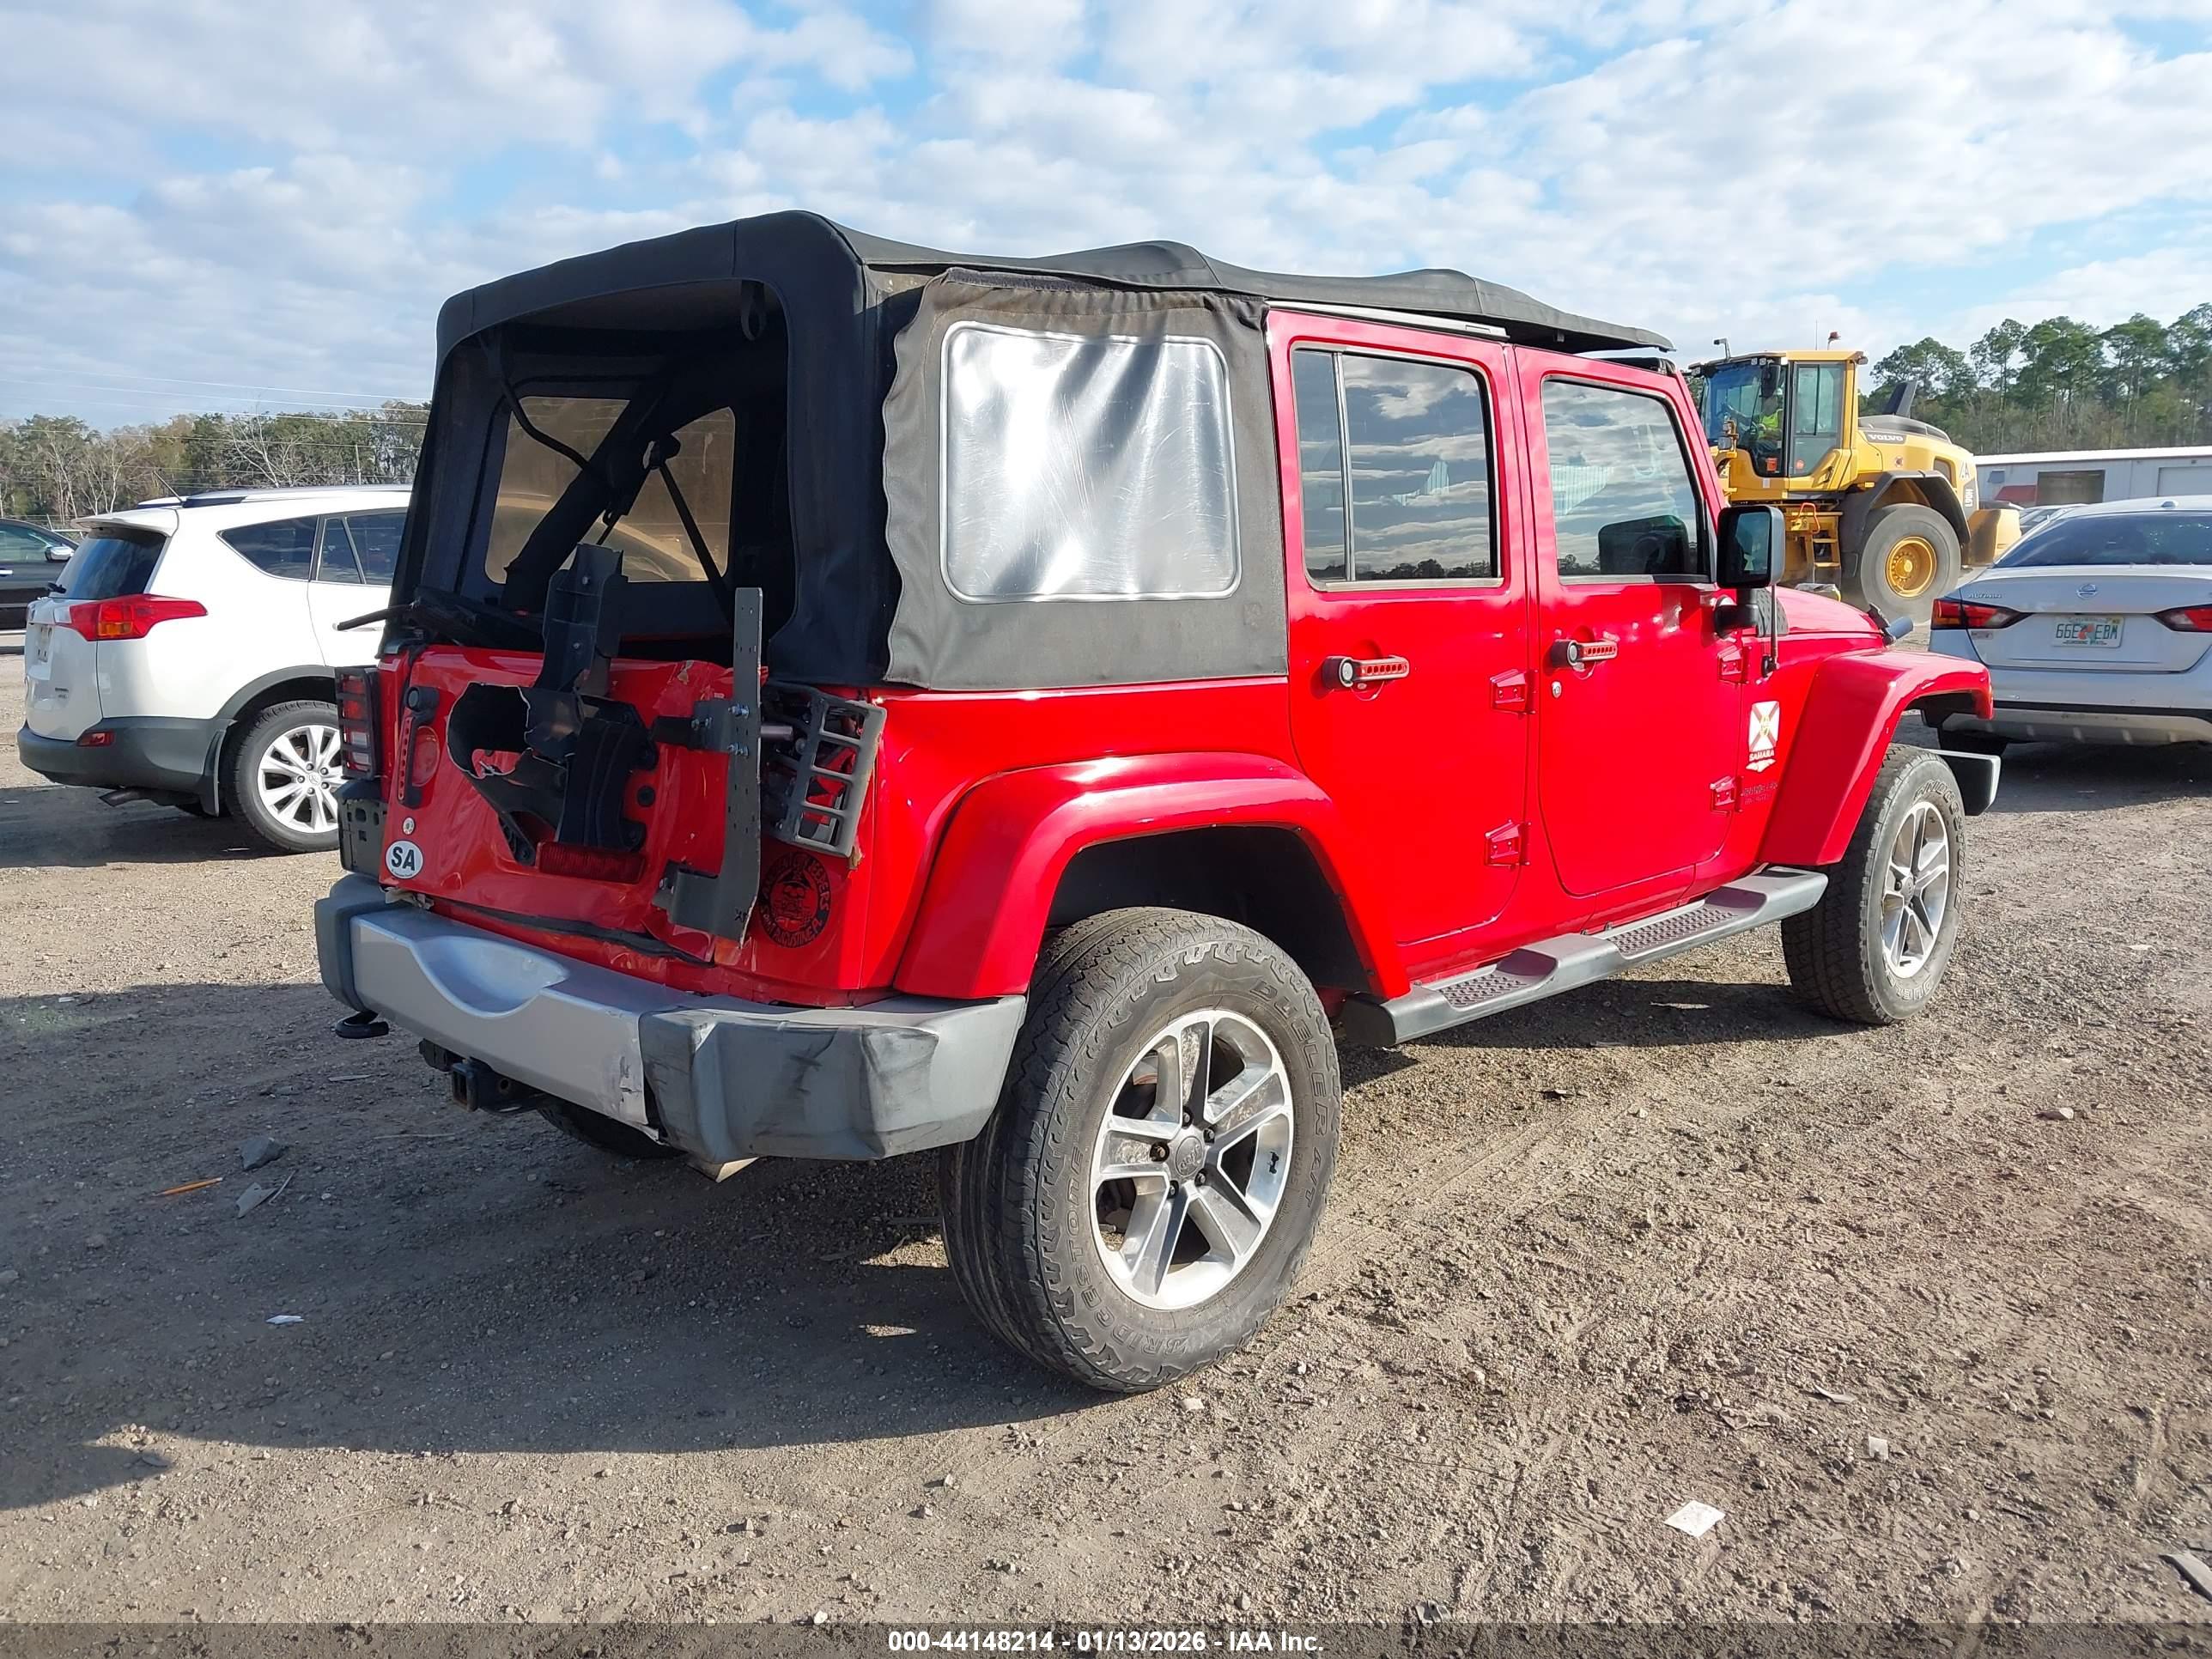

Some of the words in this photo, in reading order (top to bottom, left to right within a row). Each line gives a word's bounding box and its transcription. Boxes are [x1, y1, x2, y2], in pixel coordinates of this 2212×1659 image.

[391, 846, 416, 872] SA
[1249, 981, 1329, 1136] DUELER
[1065, 1146, 1189, 1355] BRIDGESTONE
